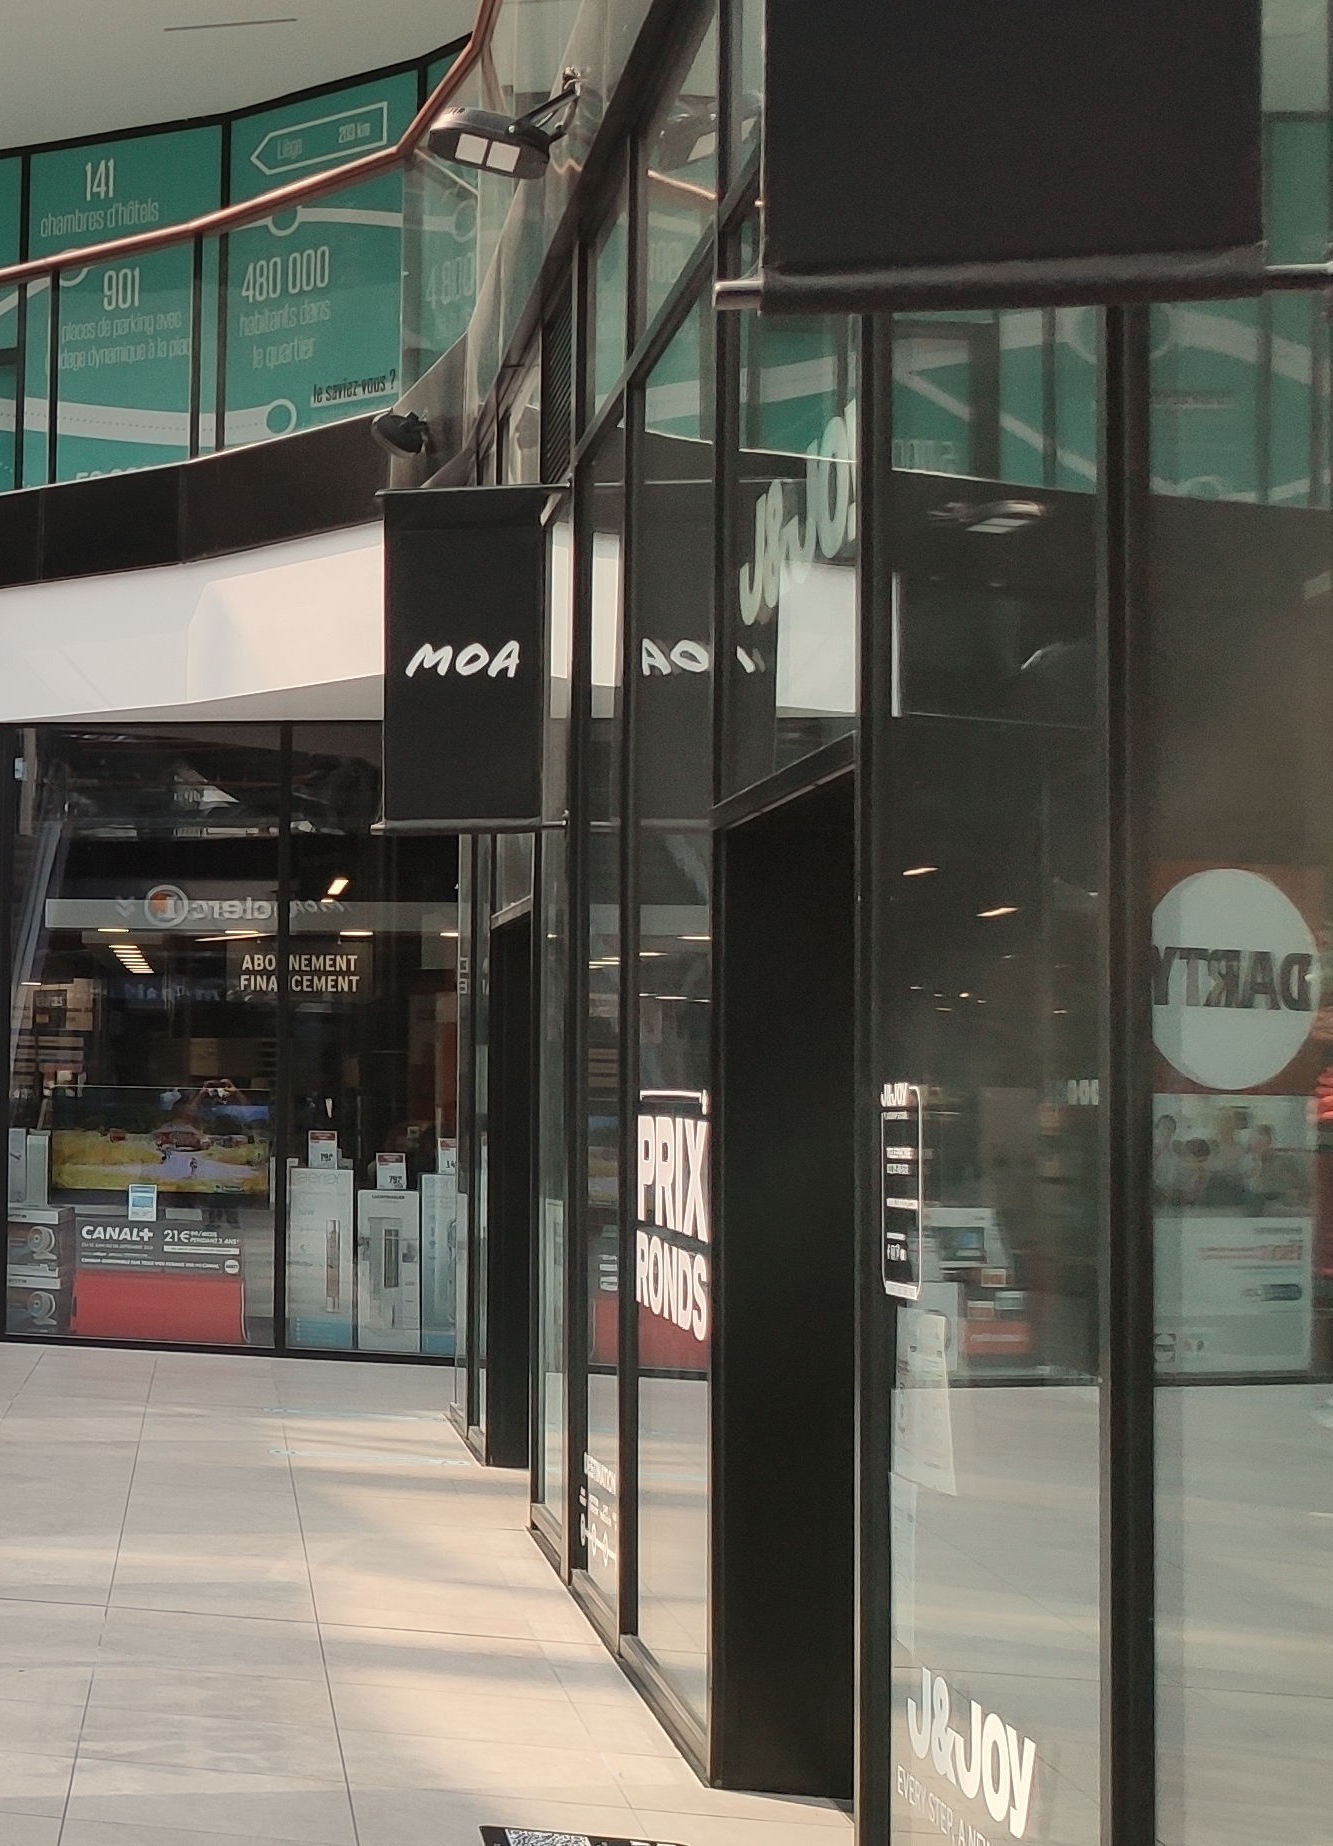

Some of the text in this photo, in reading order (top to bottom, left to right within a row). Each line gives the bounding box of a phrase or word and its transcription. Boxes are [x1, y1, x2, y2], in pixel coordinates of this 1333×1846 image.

[355, 122, 371, 138] km
[85, 158, 114, 201] 141
[40, 199, 159, 238] chambres d'hôtels
[103, 267, 140, 310] 901
[241, 246, 329, 303] 480 000
[61, 311, 182, 343] places de parking avec
[239, 300, 331, 338] habitants dans
[88, 337, 167, 368] dynamique la
[252, 335, 316, 369] le quartier
[313, 375, 386, 404] le saviez-vous
[405, 640, 520, 678] MOA
[241, 954, 359, 972] ABONEMENT
[239, 975, 361, 993] FINACEMENT
[637, 1114, 710, 1243] PRIX
[81, 1225, 154, 1243] CANAL+
[635, 1229, 709, 1342] RONDS
[906, 1665, 1037, 1840] J&JOY
[896, 1763, 927, 1811] EVERY
